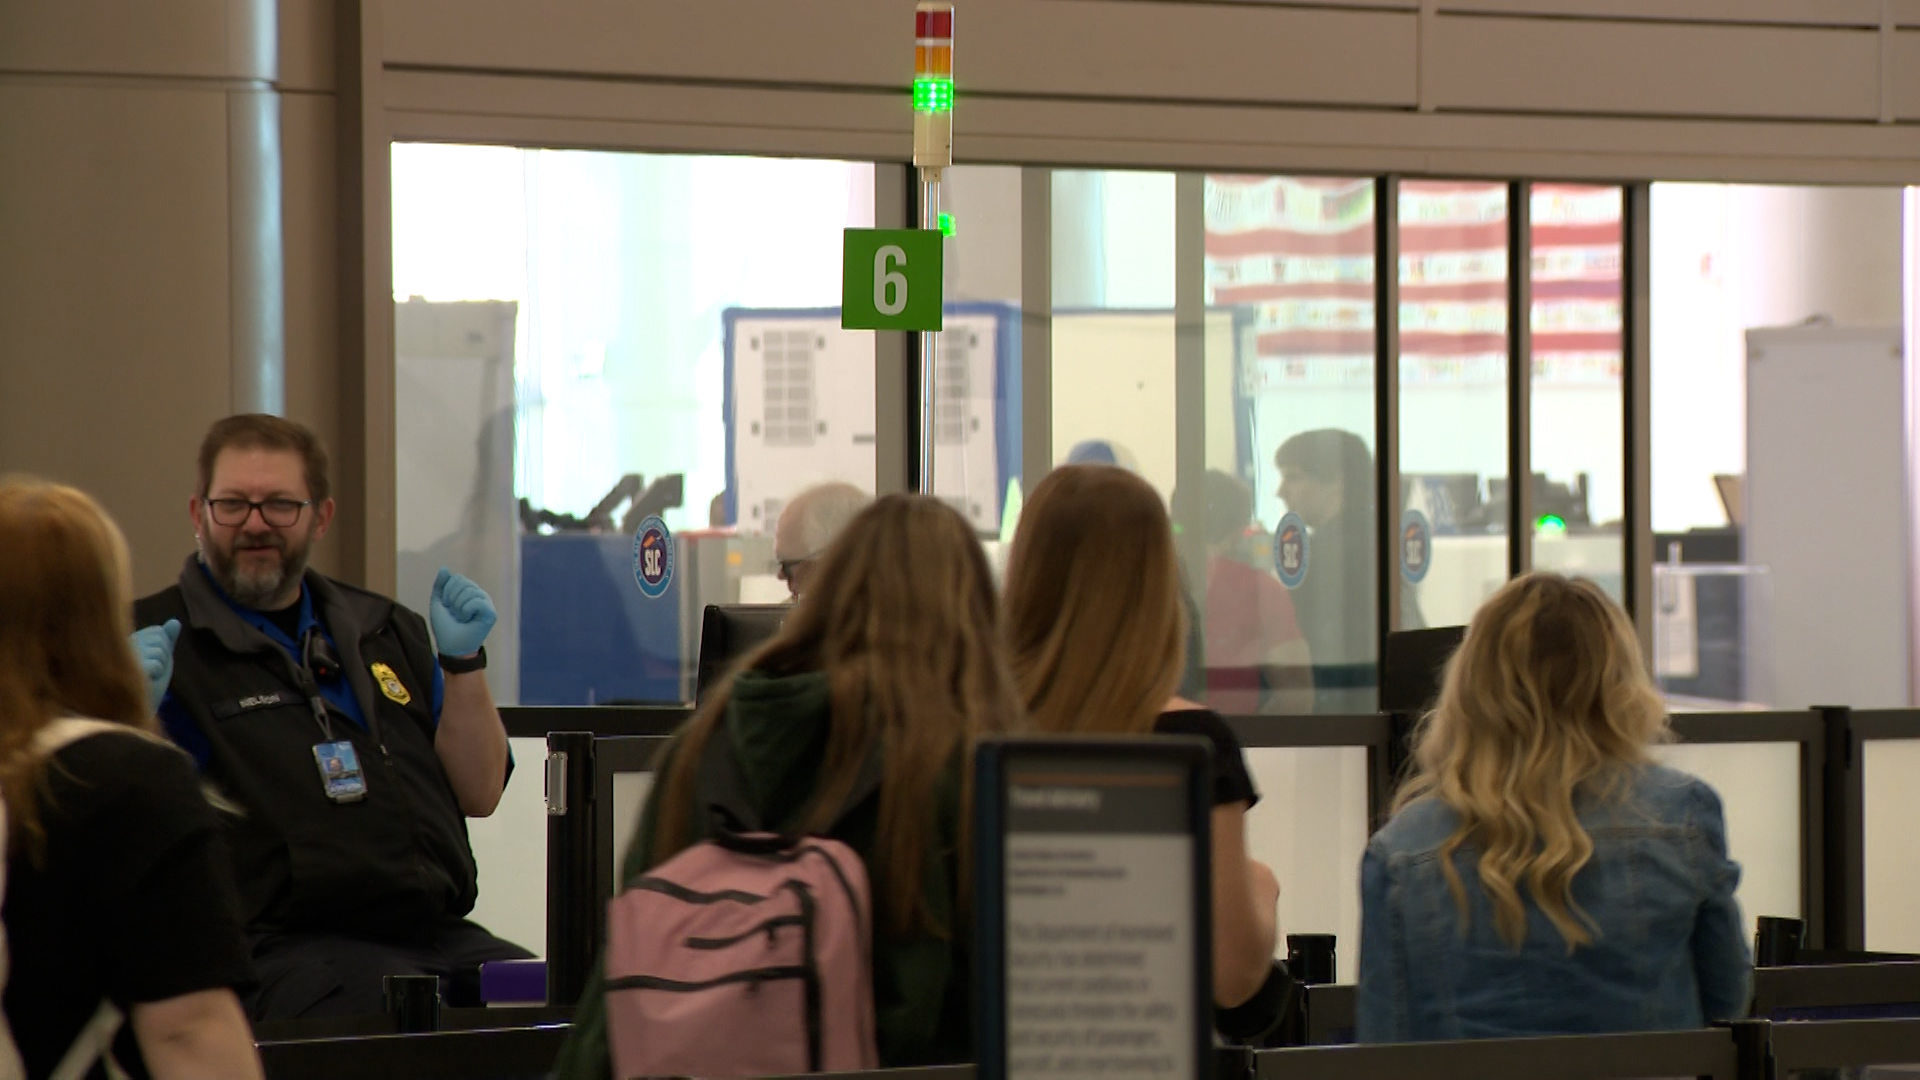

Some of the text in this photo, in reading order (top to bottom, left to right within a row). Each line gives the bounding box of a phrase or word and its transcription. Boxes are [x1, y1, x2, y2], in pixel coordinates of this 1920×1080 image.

[873, 245, 908, 316] 6
[645, 549, 661, 576] SLC
[1283, 543, 1298, 568] SLC
[1406, 539, 1422, 565] SLC
